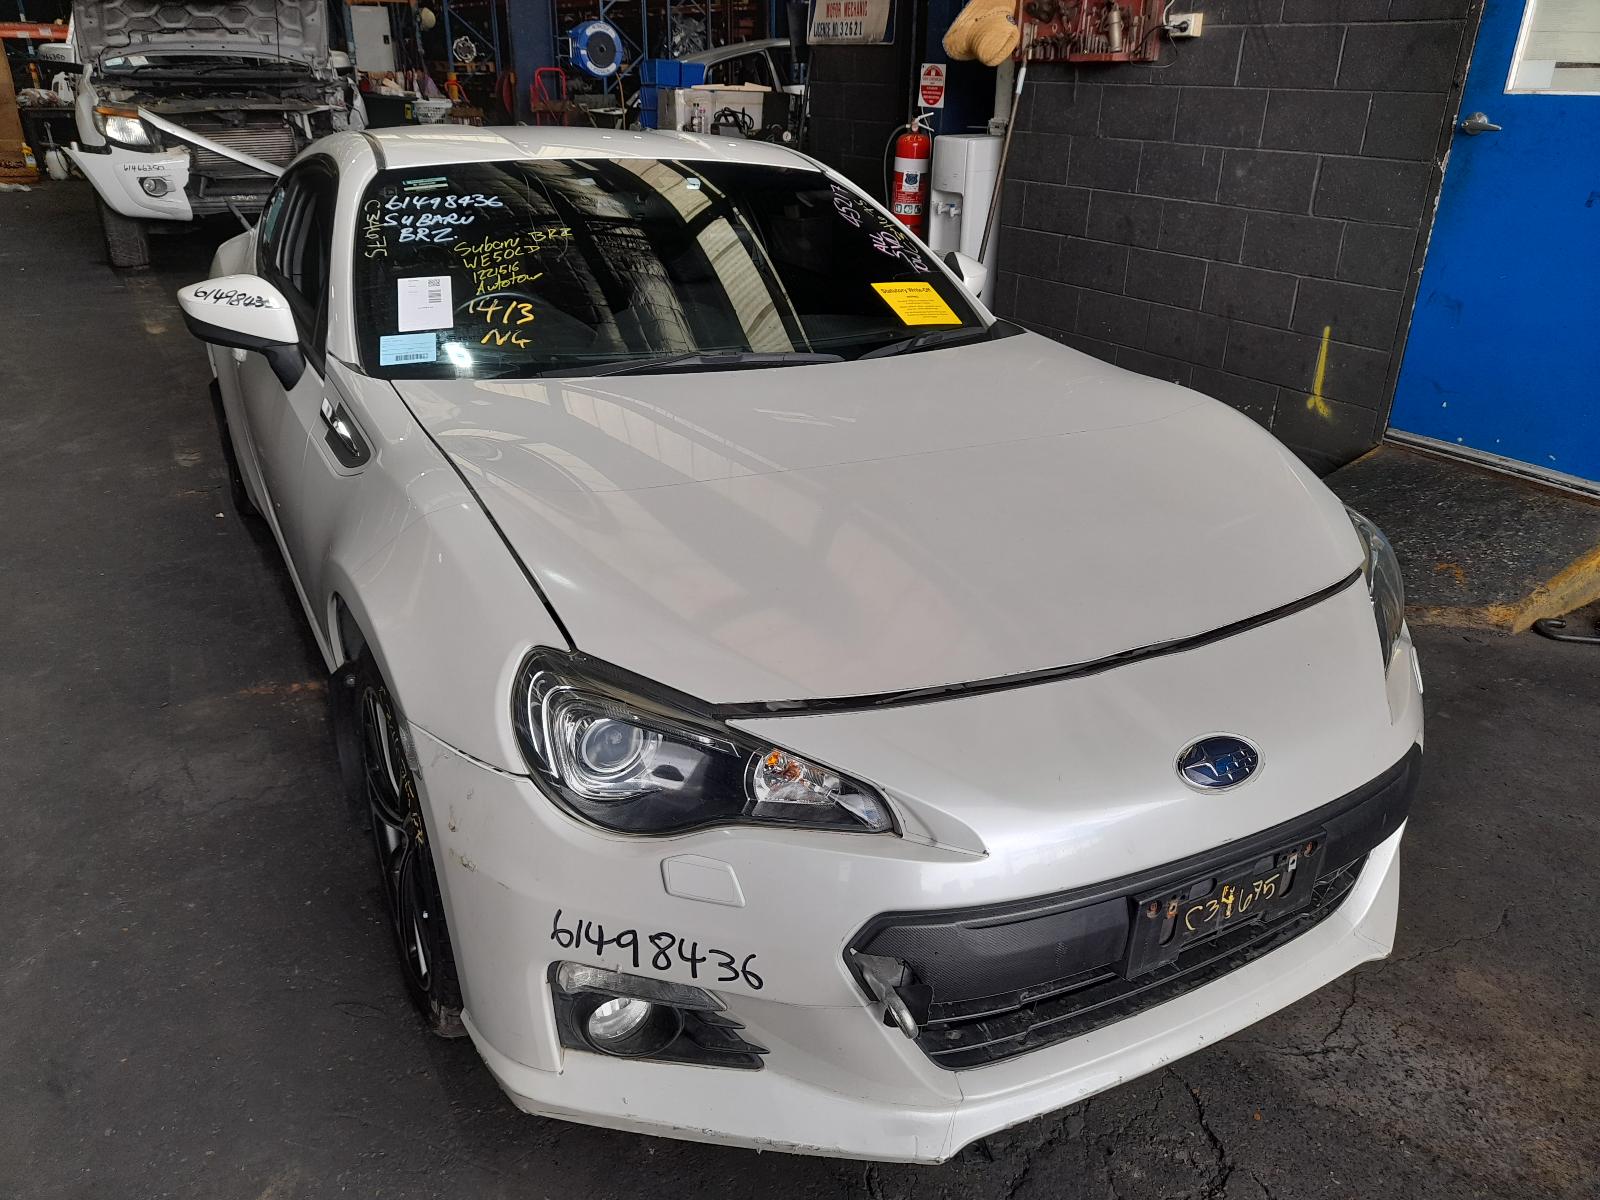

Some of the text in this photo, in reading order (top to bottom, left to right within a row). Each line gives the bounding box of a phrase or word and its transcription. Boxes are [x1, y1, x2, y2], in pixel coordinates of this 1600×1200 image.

[385, 194, 503, 211] 61498436
[1185, 873, 1281, 931] C34675
[550, 909, 764, 990] 61498436
